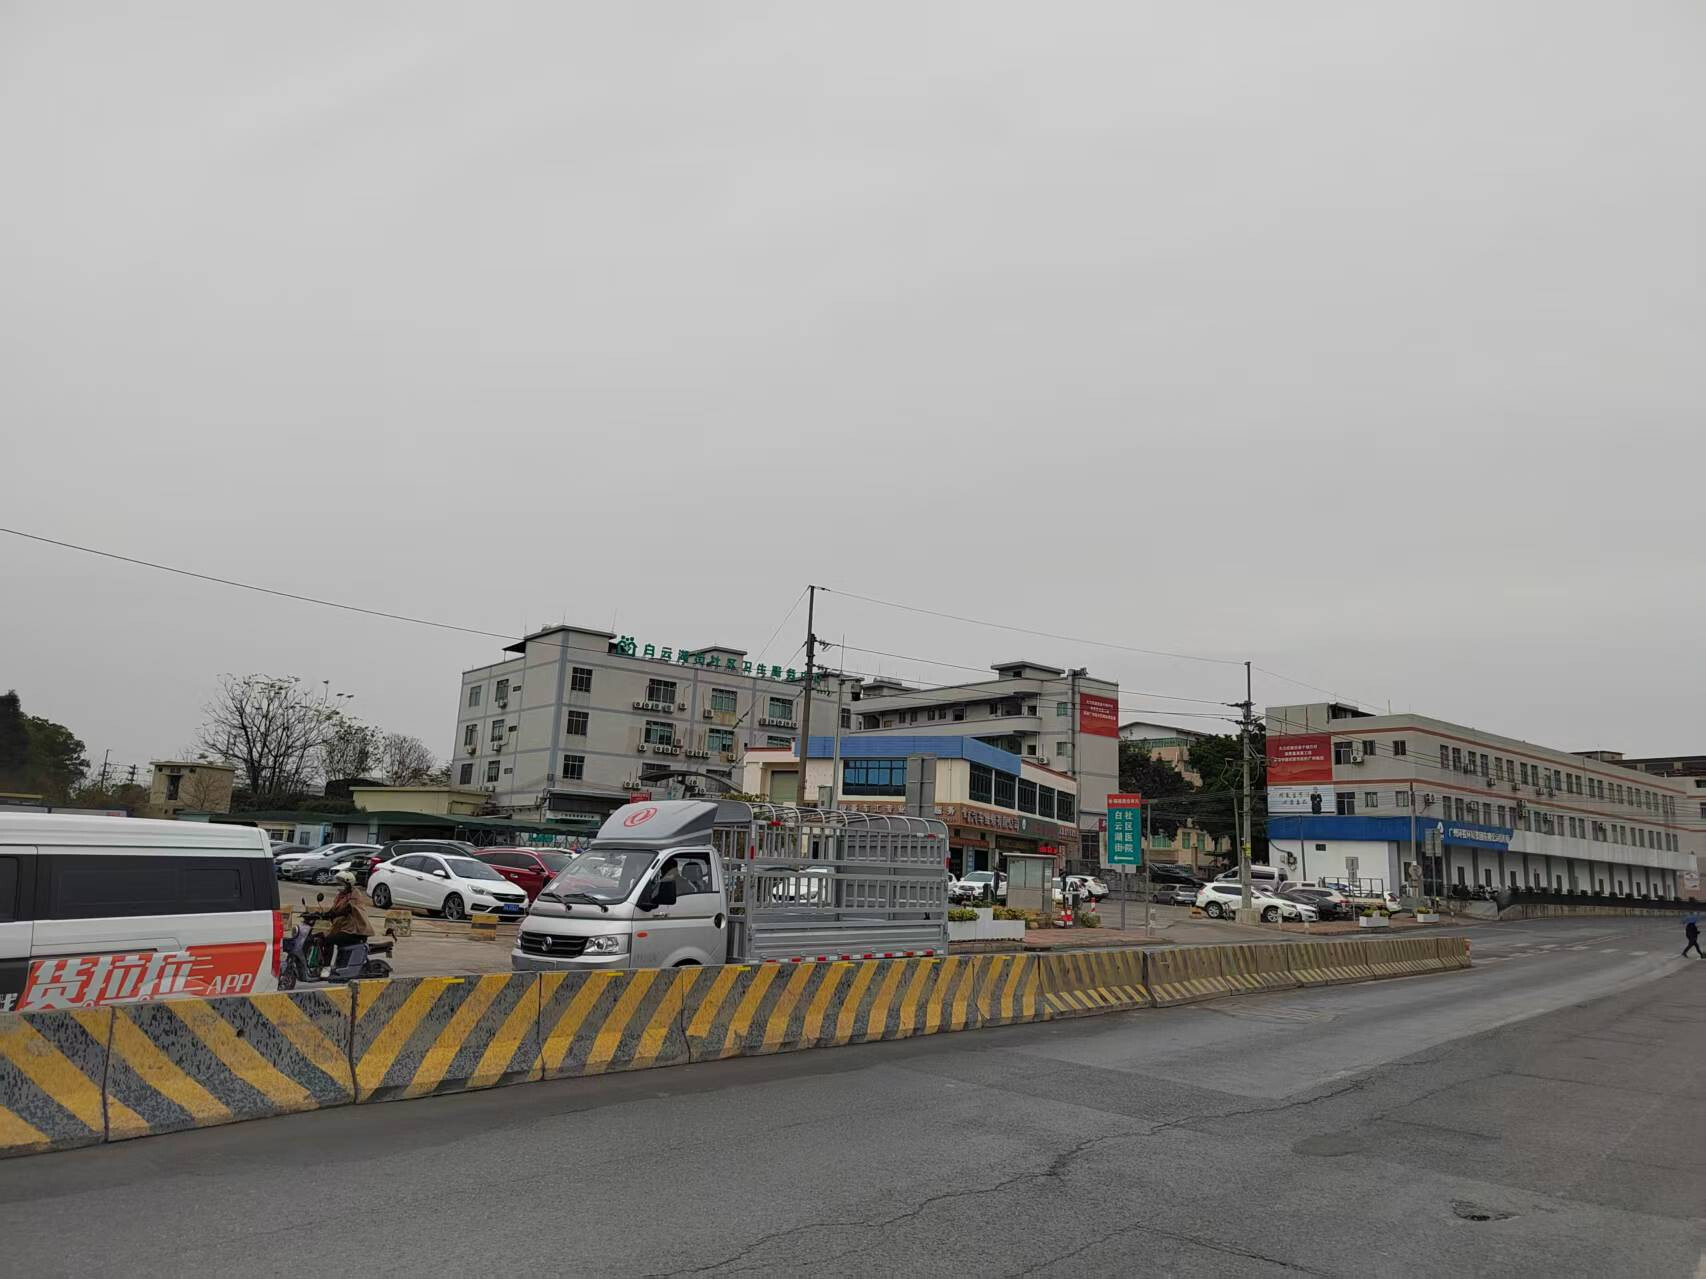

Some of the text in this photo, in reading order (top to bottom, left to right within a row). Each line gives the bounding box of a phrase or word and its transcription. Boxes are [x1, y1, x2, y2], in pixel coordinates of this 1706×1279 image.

[24, 951, 194, 1010] 货拉拉
[205, 973, 253, 995] APP
